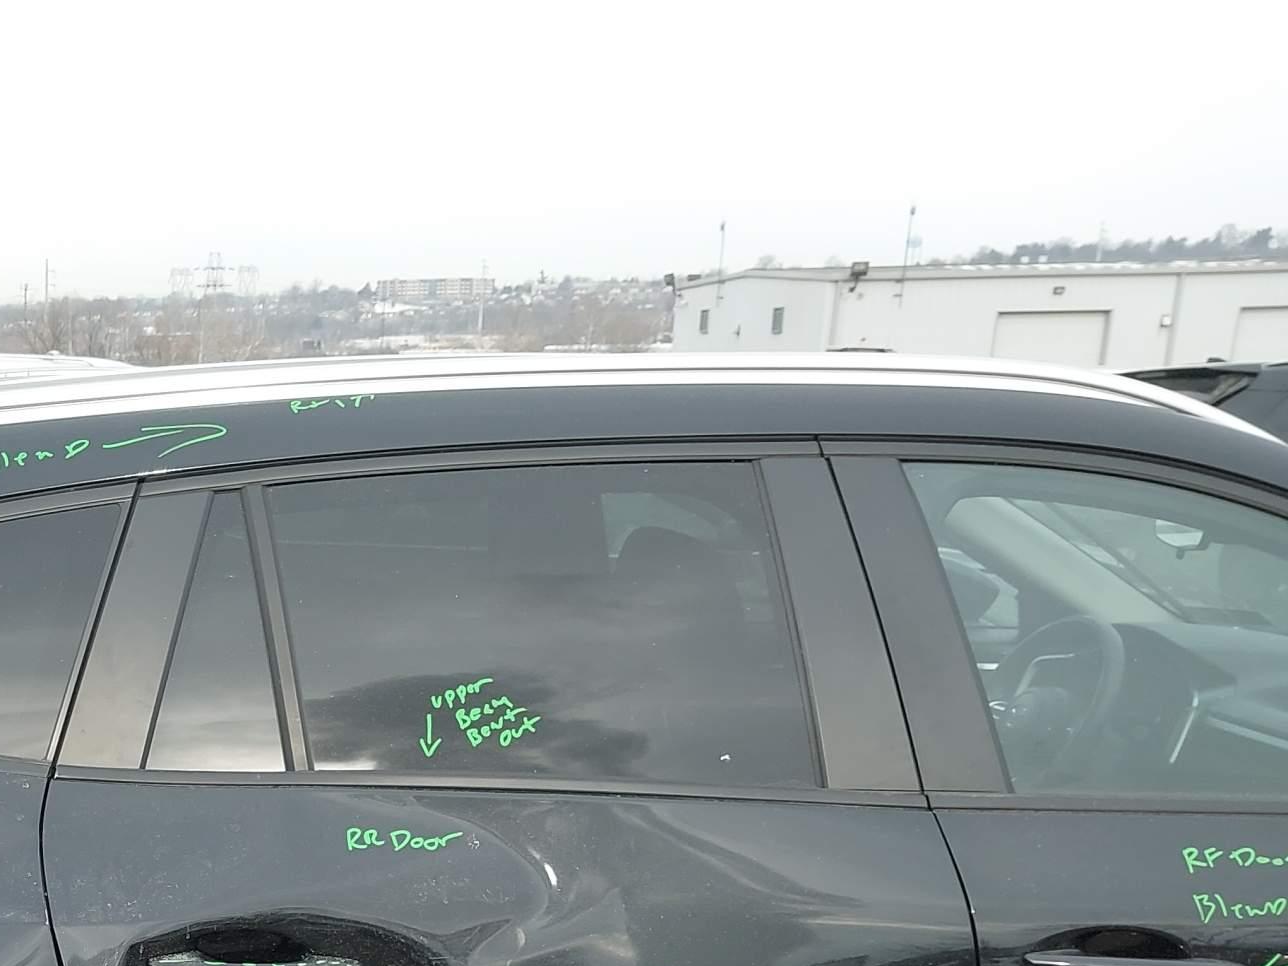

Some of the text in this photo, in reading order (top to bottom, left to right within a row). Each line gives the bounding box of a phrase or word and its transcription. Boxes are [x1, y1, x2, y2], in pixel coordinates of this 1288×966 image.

[346, 828, 464, 851] RR Door
[1182, 847, 1288, 874] RF Doo
